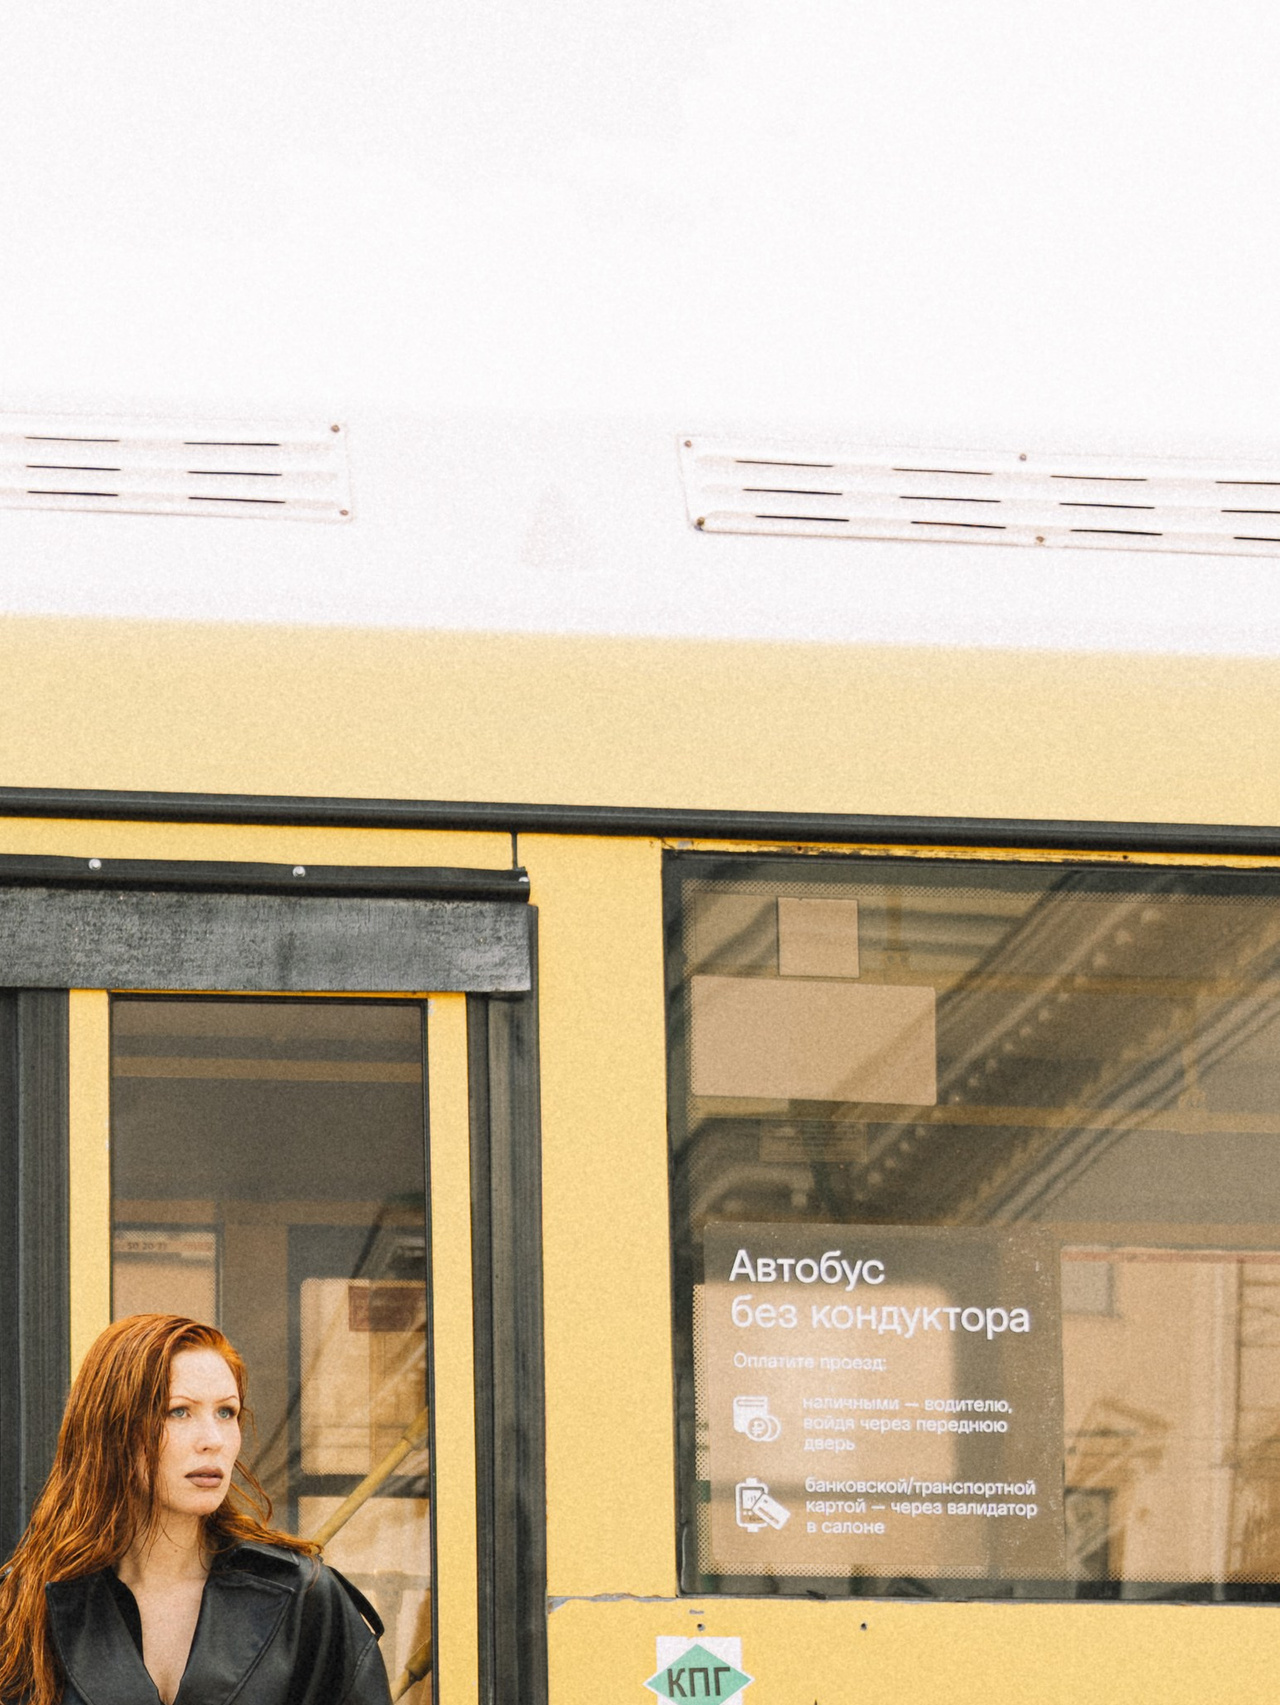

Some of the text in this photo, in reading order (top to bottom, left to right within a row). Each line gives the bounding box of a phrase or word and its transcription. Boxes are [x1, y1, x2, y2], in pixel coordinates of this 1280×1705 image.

[728, 1249, 885, 1292] Автобус
[731, 1294, 1031, 1340] без кондуктора
[733, 1352, 887, 1372] Оплатите проезд:
[802, 1397, 900, 1411] наличными
[924, 1399, 1013, 1414] водителю,
[803, 1415, 1008, 1435] войдя через переднюю
[803, 1437, 856, 1453] дверь
[805, 1476, 1037, 1498] банковской/транспортной
[806, 1498, 867, 1516] картой
[890, 1501, 942, 1518] через
[947, 1502, 1038, 1519] валидатор
[806, 1521, 885, 1535] в салоне
[667, 1666, 730, 1698] КПГ
